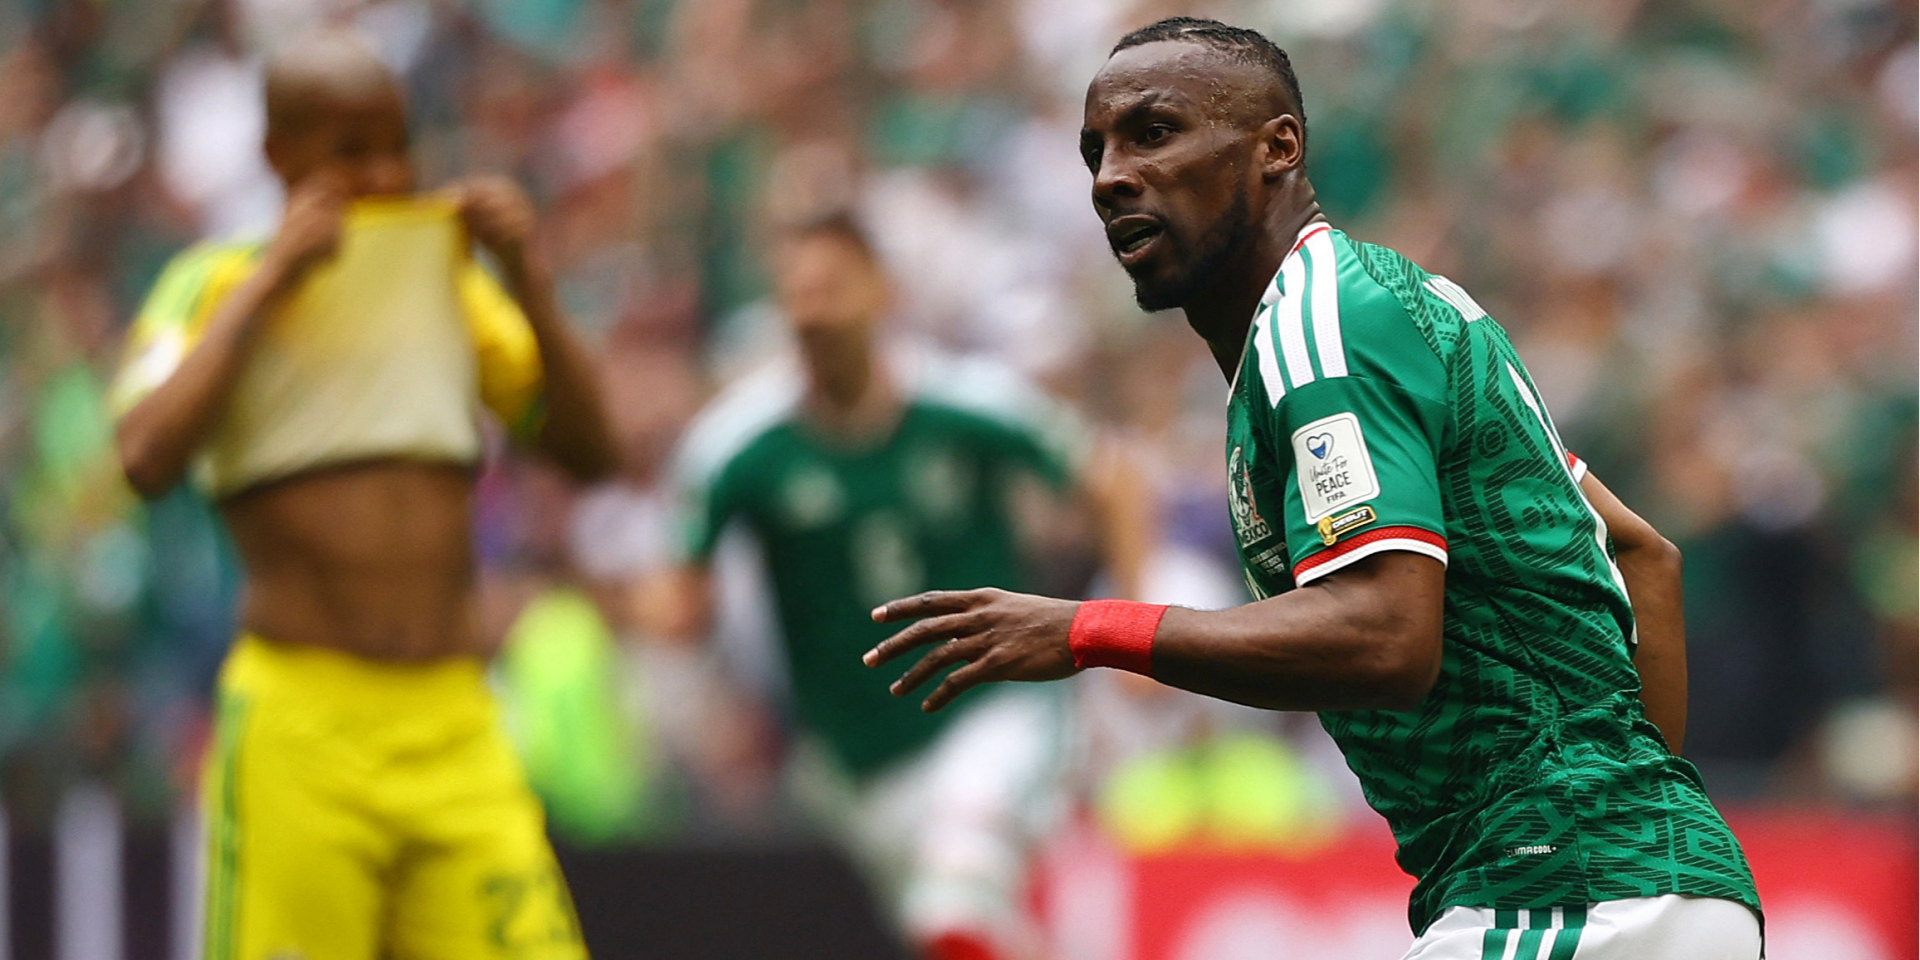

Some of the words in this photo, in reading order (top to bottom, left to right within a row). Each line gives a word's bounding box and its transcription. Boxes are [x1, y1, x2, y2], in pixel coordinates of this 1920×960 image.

[1310, 463, 1333, 482] Unite
[1331, 455, 1348, 471] For
[1315, 471, 1352, 497] PEACE
[1326, 491, 1347, 504] FIFA
